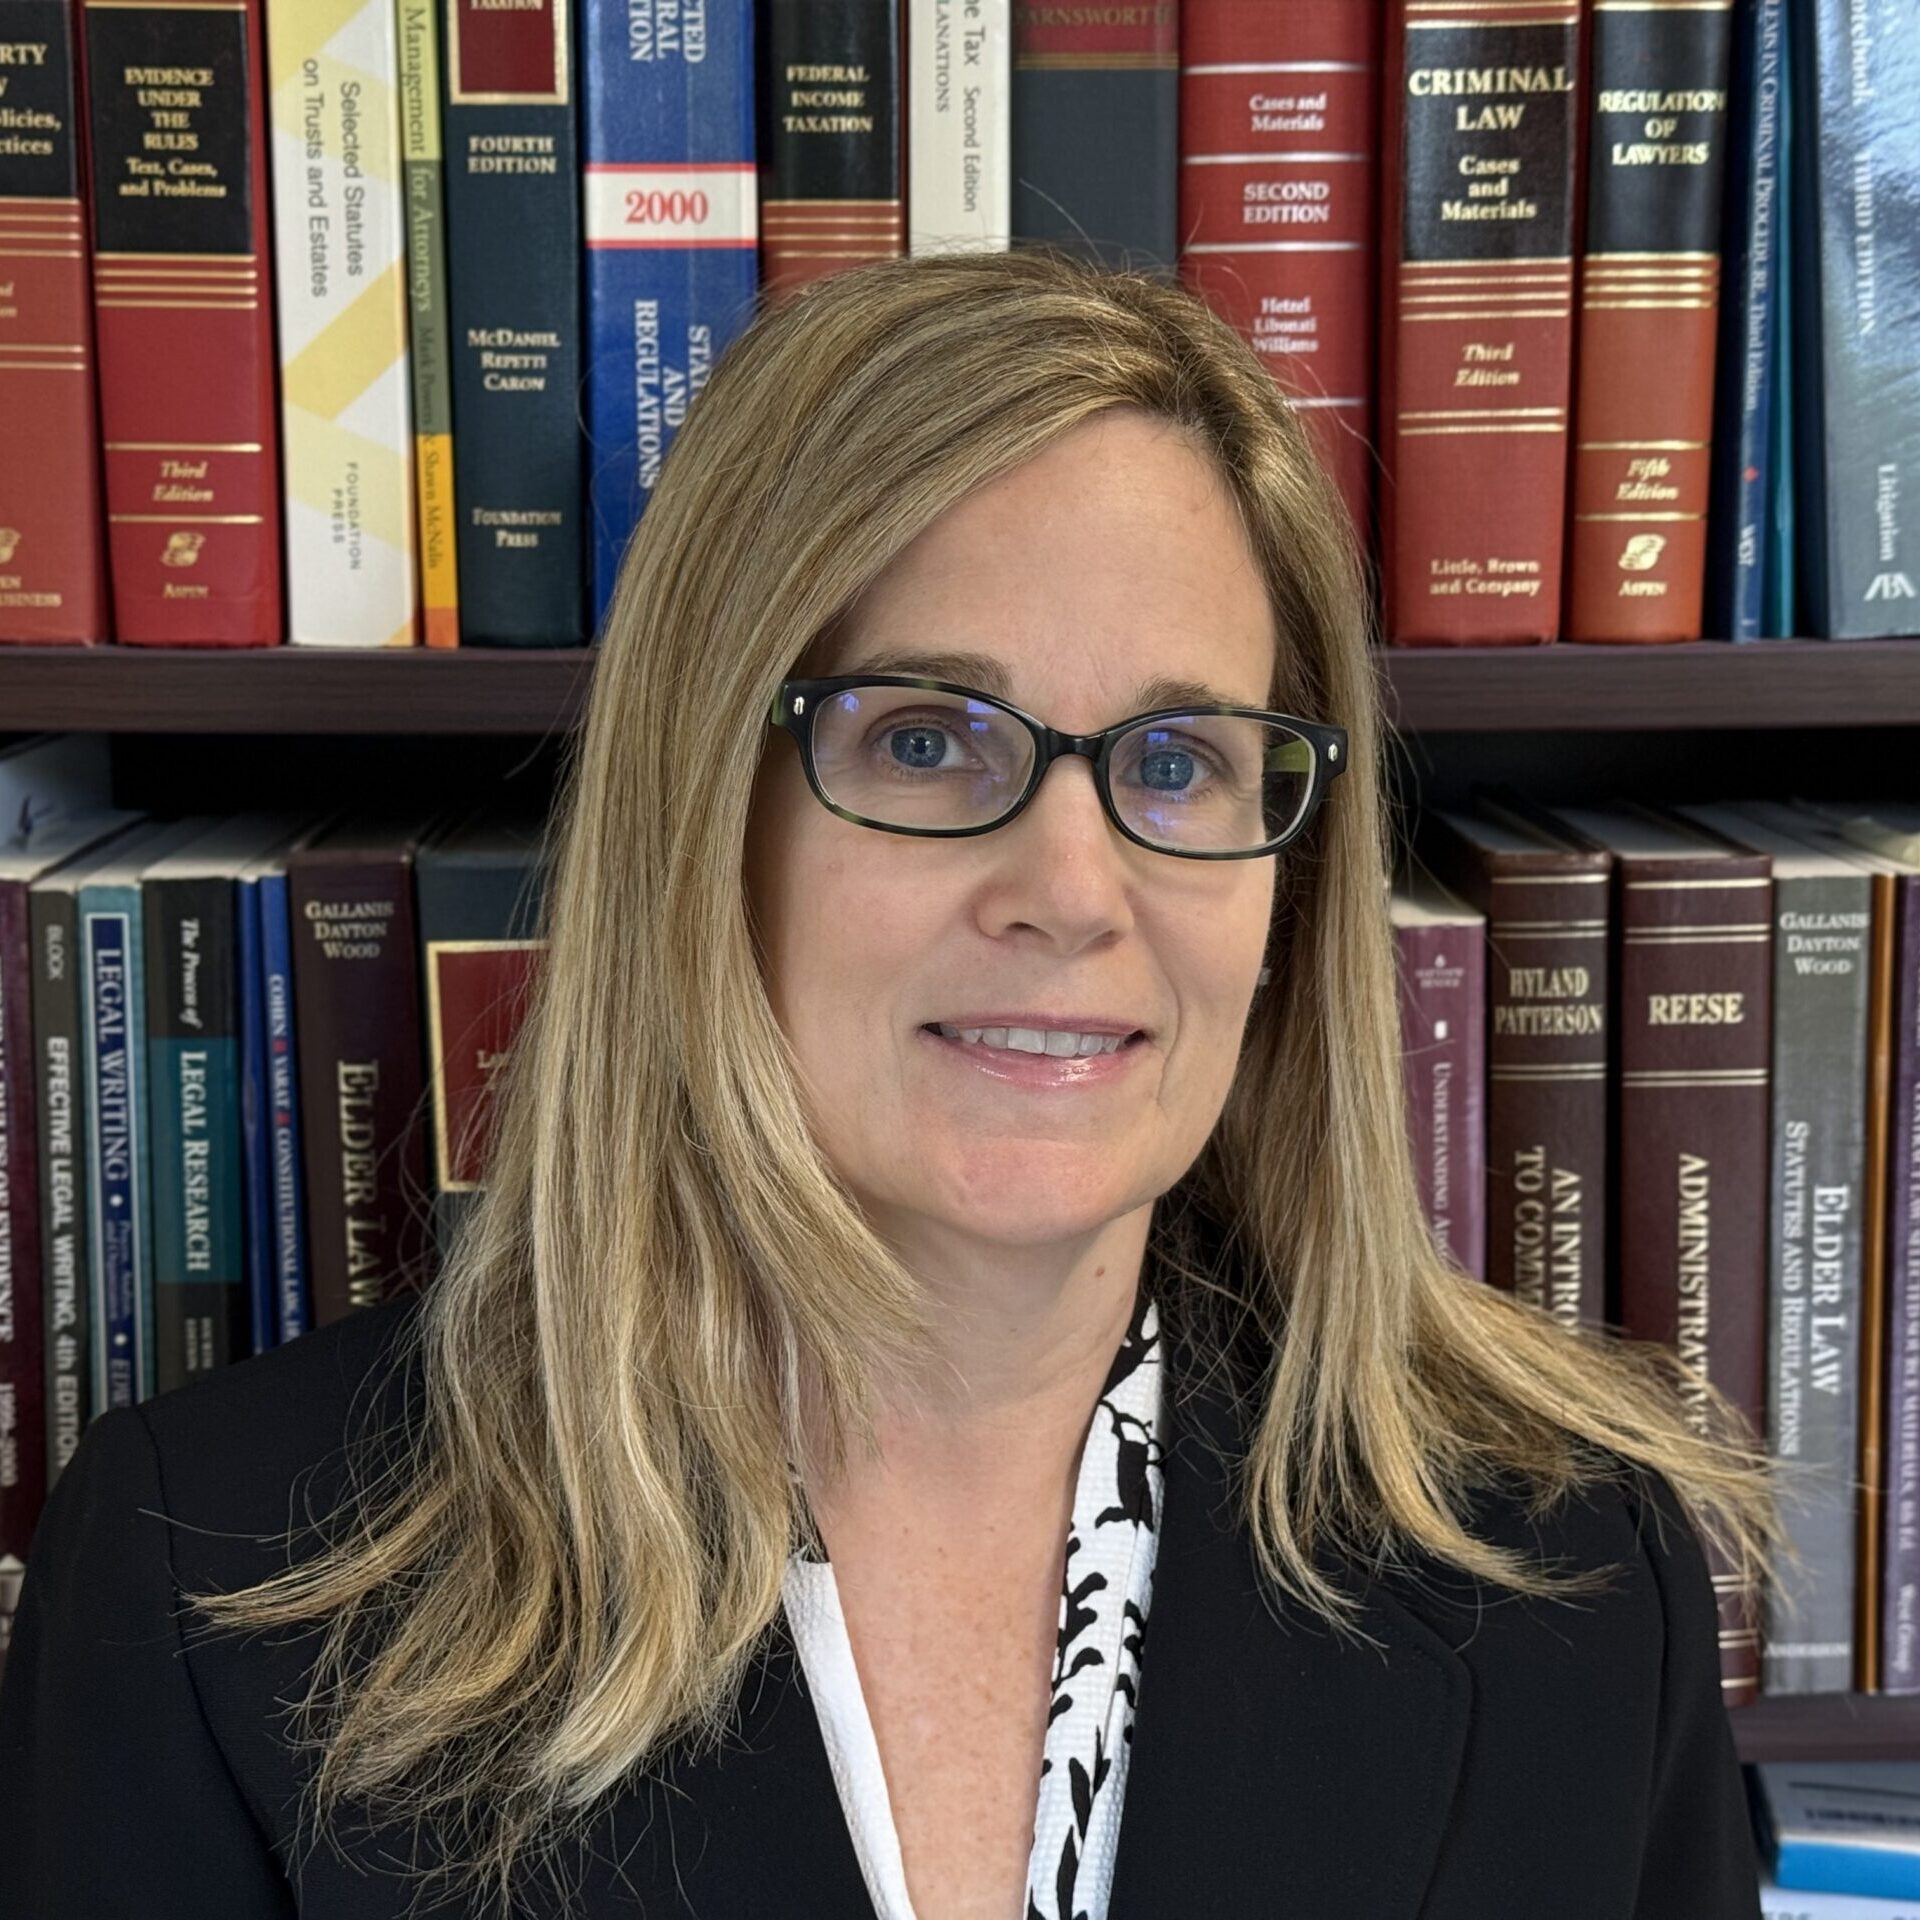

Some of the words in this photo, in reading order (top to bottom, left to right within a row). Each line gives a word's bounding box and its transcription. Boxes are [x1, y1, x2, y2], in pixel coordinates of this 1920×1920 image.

[964, 28, 985, 66] Tax
[124, 66, 214, 86] EVIDENCE
[303, 58, 319, 88] on
[402, 7, 426, 154] Management
[786, 65, 870, 82] FEDERAL
[1408, 67, 1575, 96] CRIMINAL
[137, 89, 202, 107] UNDER
[791, 91, 864, 107] INCOME
[1249, 94, 1294, 111] Cases
[1296, 93, 1326, 111] and
[1598, 90, 1725, 113] REGULATION
[0, 108, 62, 132] licies,
[151, 111, 191, 128] THE
[305, 93, 325, 160] Trusts
[340, 81, 362, 179] Selected
[784, 117, 872, 132] TAXATION
[964, 87, 980, 148] Second
[1251, 115, 1325, 131] Materials
[1455, 105, 1525, 131] LAW
[1644, 118, 1678, 139] OF
[1756, 78, 1778, 173] CRIMINAL
[143, 132, 199, 150] RULES
[468, 136, 555, 153] FOURTH
[1611, 143, 1710, 166] LAWYERS
[126, 157, 165, 175] Text,
[167, 158, 218, 177] Cases,
[468, 157, 557, 174] EDITION
[1458, 155, 1520, 175] Cases
[118, 180, 149, 196] and
[152, 179, 227, 197] Problems
[307, 166, 328, 208] and
[411, 167, 433, 199] for
[964, 156, 980, 212] Edition
[1243, 182, 1330, 201] SECOND
[1468, 177, 1509, 197] and
[1854, 151, 1874, 228] THIRD
[624, 190, 709, 225] 2000
[1243, 205, 1330, 223] EDITION
[1440, 200, 1538, 221] Materials
[344, 186, 364, 277] Statutes
[309, 215, 329, 298] Estates
[410, 206, 434, 313] Attorneys
[1854, 234, 1875, 336] EDITION
[481, 353, 547, 369] REPETTI
[1463, 343, 1515, 362] Third
[484, 375, 545, 391] CARON
[1454, 368, 1520, 387] Edition
[635, 300, 661, 490] REGULATIONS
[663, 367, 685, 427] AND
[160, 461, 208, 479] Third
[424, 451, 439, 500] Shawn
[1626, 458, 1672, 481] Fifth
[153, 484, 214, 502] Edition
[1615, 481, 1679, 501] Edition
[332, 488, 345, 544] PRESS
[346, 461, 361, 570] FOUNDATION
[472, 509, 562, 525] FOUNDATION
[1877, 464, 1900, 561] Litigation
[1430, 559, 1483, 576] Little,
[1487, 558, 1540, 574] Brown
[1430, 578, 1461, 595] and
[1466, 577, 1541, 598] Company
[305, 901, 394, 920] GALLANIS
[1779, 912, 1870, 930] GALLANIS
[180, 918, 198, 947] The
[314, 922, 387, 940] DAYTON
[1787, 935, 1860, 953] DAYTON
[47, 925, 63, 980] BLOCK
[323, 942, 381, 960] WOOD
[1794, 958, 1851, 975] WOOD
[96, 949, 123, 1042] LEGAL
[1509, 967, 1590, 997] HYLAND
[180, 1008, 203, 1030] of
[269, 974, 286, 1036] COHEN
[1494, 1005, 1603, 1035] PATTERSON
[1648, 993, 1744, 1025] REESE
[48, 1037, 71, 1154] EFFECTIVE
[181, 1051, 206, 1135] LEGAL
[274, 1056, 291, 1108] VARAT
[101, 1049, 129, 1181] WRITING
[337, 1060, 379, 1205] ELDER
[1433, 1062, 1452, 1211] UNDERSTANDING
[1514, 1146, 1545, 1193] TO
[1783, 1120, 1810, 1238] STATUTES
[51, 1158, 74, 1230] LEGAL
[183, 1140, 210, 1271] RESEARCH
[276, 1127, 297, 1273] CONSTITUTIONAL
[1552, 1168, 1581, 1213] AN
[1813, 1185, 1849, 1306] ELDER
[346, 1215, 387, 1307] LAW
[1782, 1243, 1803, 1292] AND
[53, 1235, 76, 1330] WRITING,
[56, 1334, 76, 1370] 4th
[1810, 1313, 1847, 1395] LAW
[1779, 1297, 1805, 1457] REGULATIONS
[56, 1376, 79, 1468] EDITION
